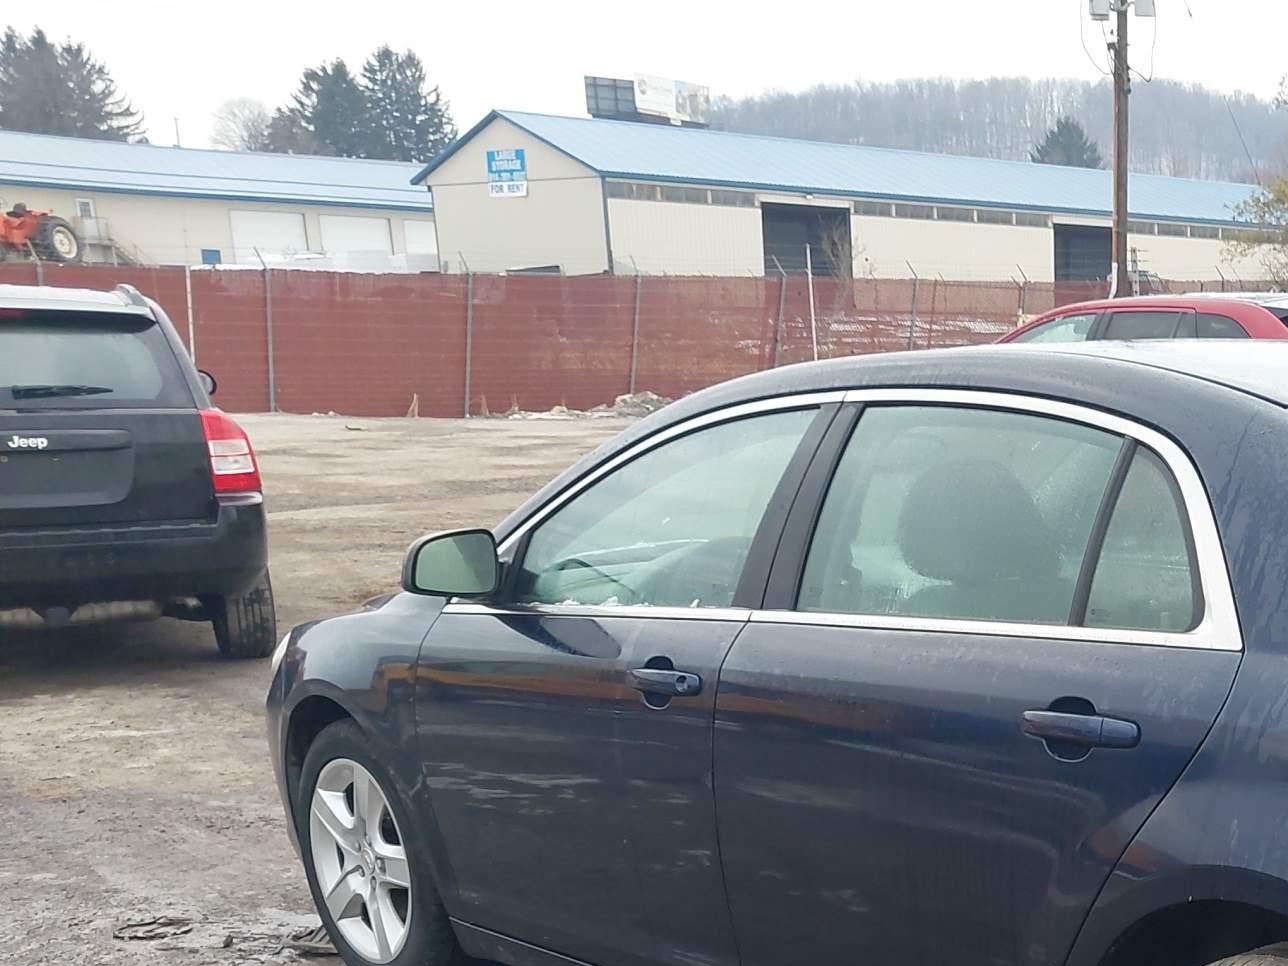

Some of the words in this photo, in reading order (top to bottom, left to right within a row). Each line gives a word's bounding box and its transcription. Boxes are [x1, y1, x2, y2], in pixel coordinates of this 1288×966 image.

[490, 184, 504, 193] FOR
[507, 183, 524, 193] RENT
[7, 435, 48, 450] Jeep
